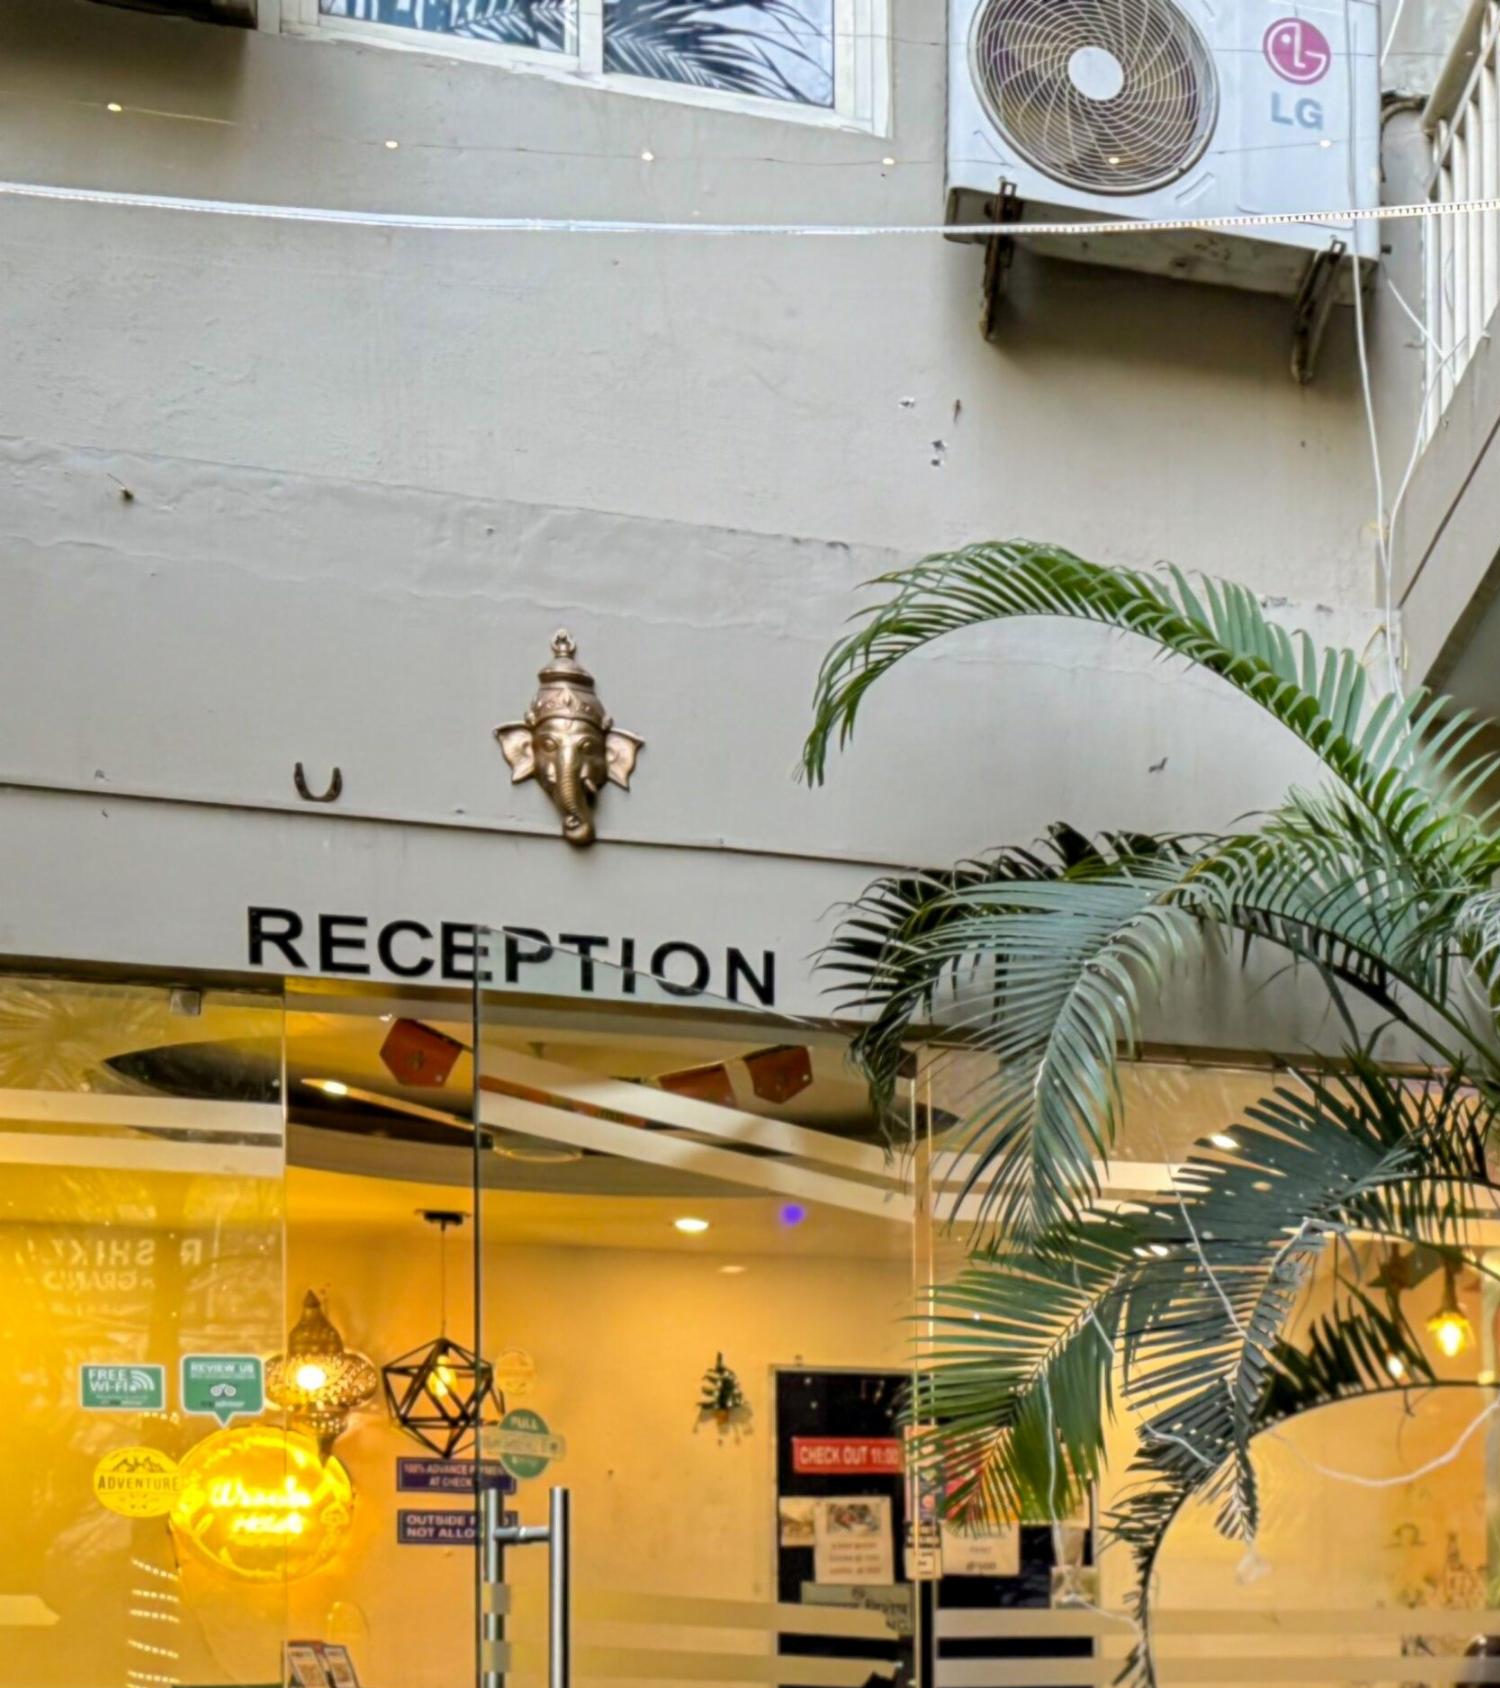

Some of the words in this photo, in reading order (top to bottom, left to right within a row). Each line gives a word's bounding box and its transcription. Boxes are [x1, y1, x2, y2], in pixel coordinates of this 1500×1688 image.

[1271, 91, 1324, 131] LG
[247, 905, 776, 1007] RECEPTION
[190, 1362, 235, 1373] REVIEW
[239, 1362, 254, 1373] US
[88, 1368, 124, 1381] FREE
[89, 1380, 129, 1392] WI-FI
[800, 1446, 842, 1465] CHECK
[843, 1447, 869, 1465] OUT
[426, 1464, 468, 1475] ADVANCE
[97, 1475, 180, 1492] ADVENTURE
[406, 1514, 466, 1526] OUTSIDE
[406, 1527, 435, 1538] NOT
